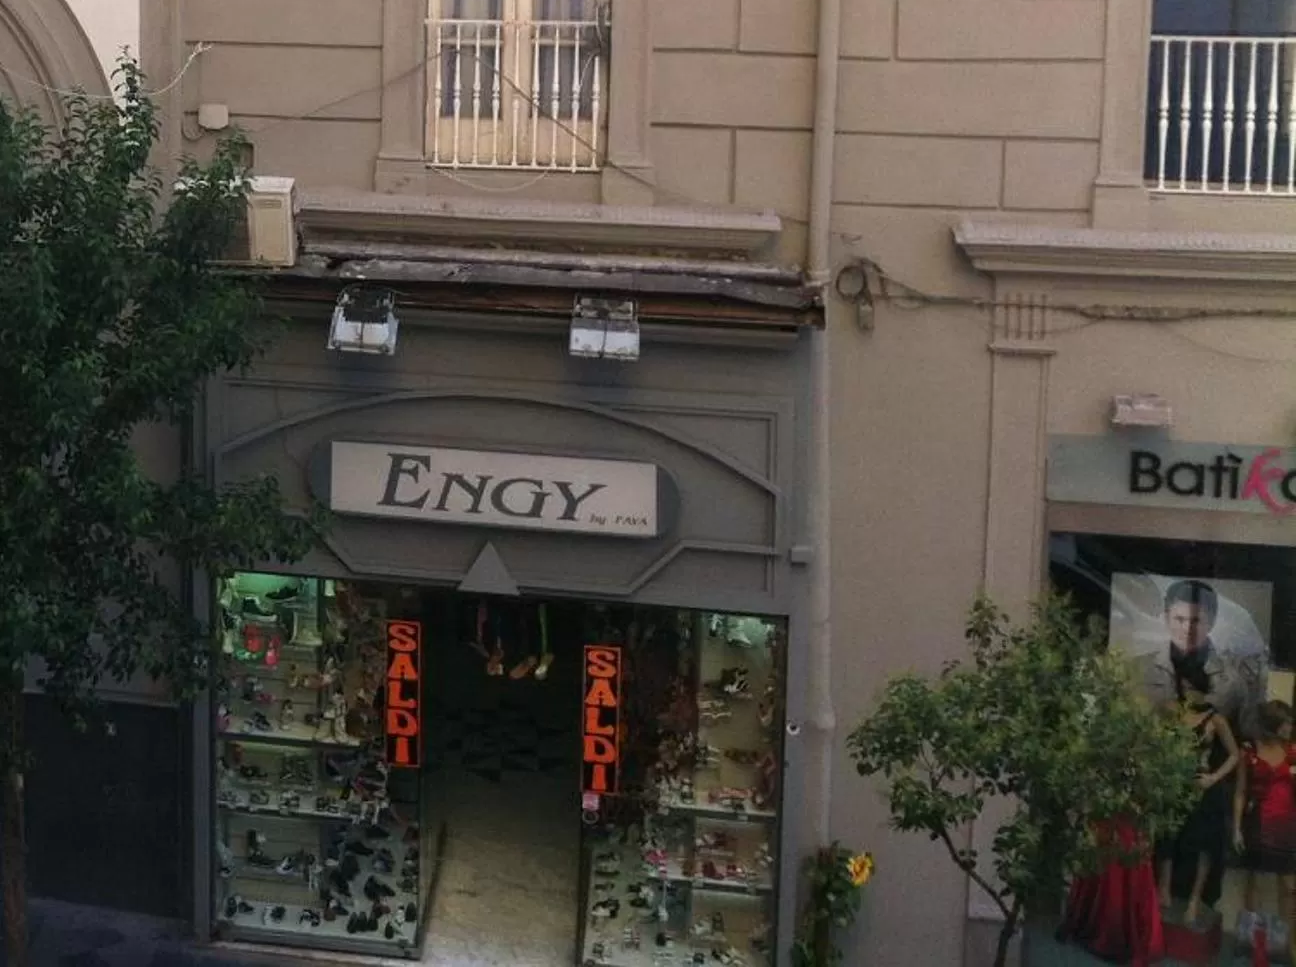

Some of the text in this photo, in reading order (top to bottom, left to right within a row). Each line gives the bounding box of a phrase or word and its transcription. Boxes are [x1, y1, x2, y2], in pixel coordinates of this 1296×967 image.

[377, 451, 607, 521] ENGY
[387, 623, 418, 763] SALDI
[584, 649, 617, 790] SALDI
